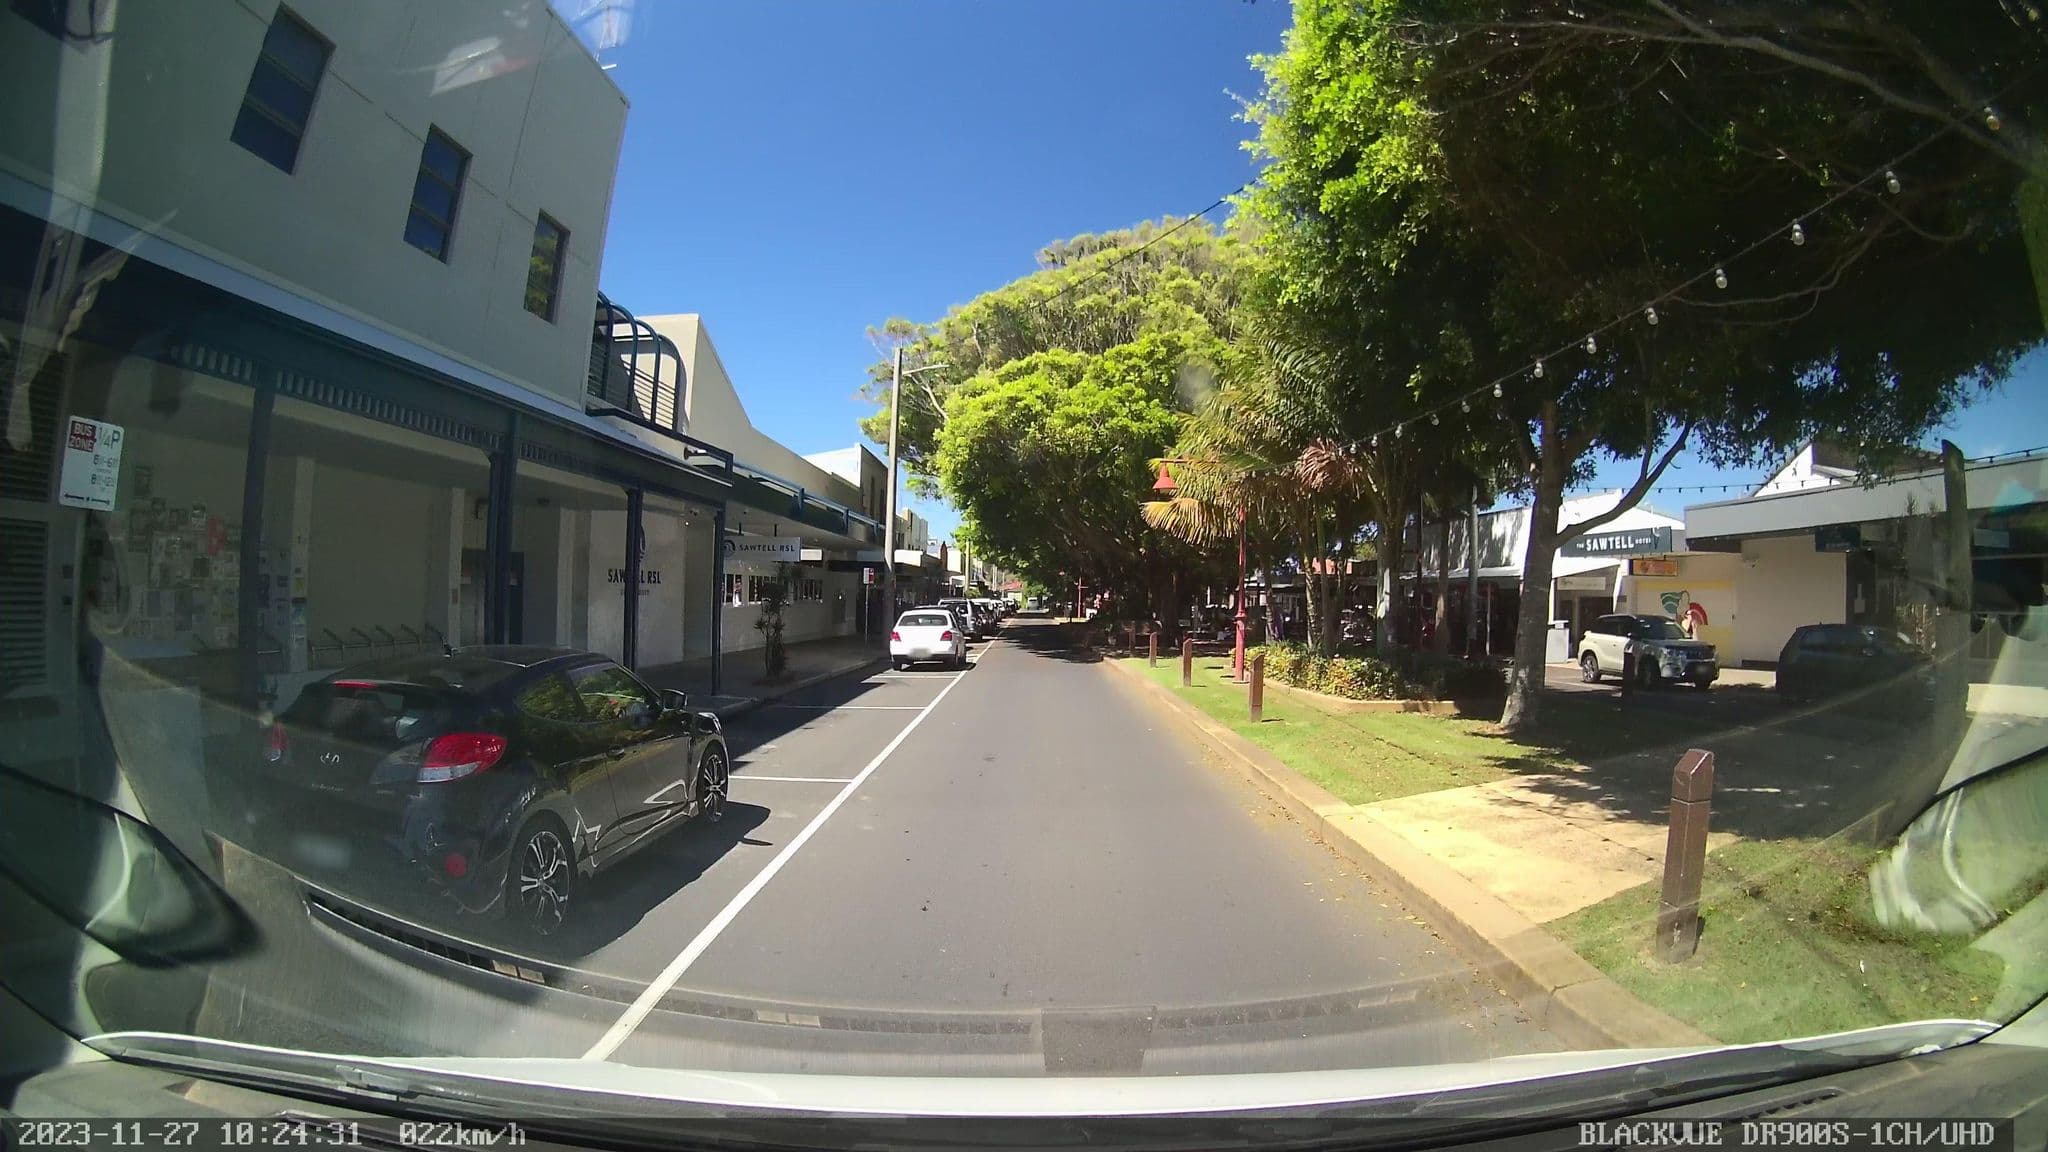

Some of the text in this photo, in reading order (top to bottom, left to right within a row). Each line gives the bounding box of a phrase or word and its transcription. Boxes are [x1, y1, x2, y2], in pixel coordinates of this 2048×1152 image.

[74, 422, 93, 438] BUS
[70, 435, 95, 450] ZONE
[739, 544, 795, 552] SAWTELL RSL
[1586, 536, 1634, 551] SAWTELL
[647, 571, 662, 584] RSL
